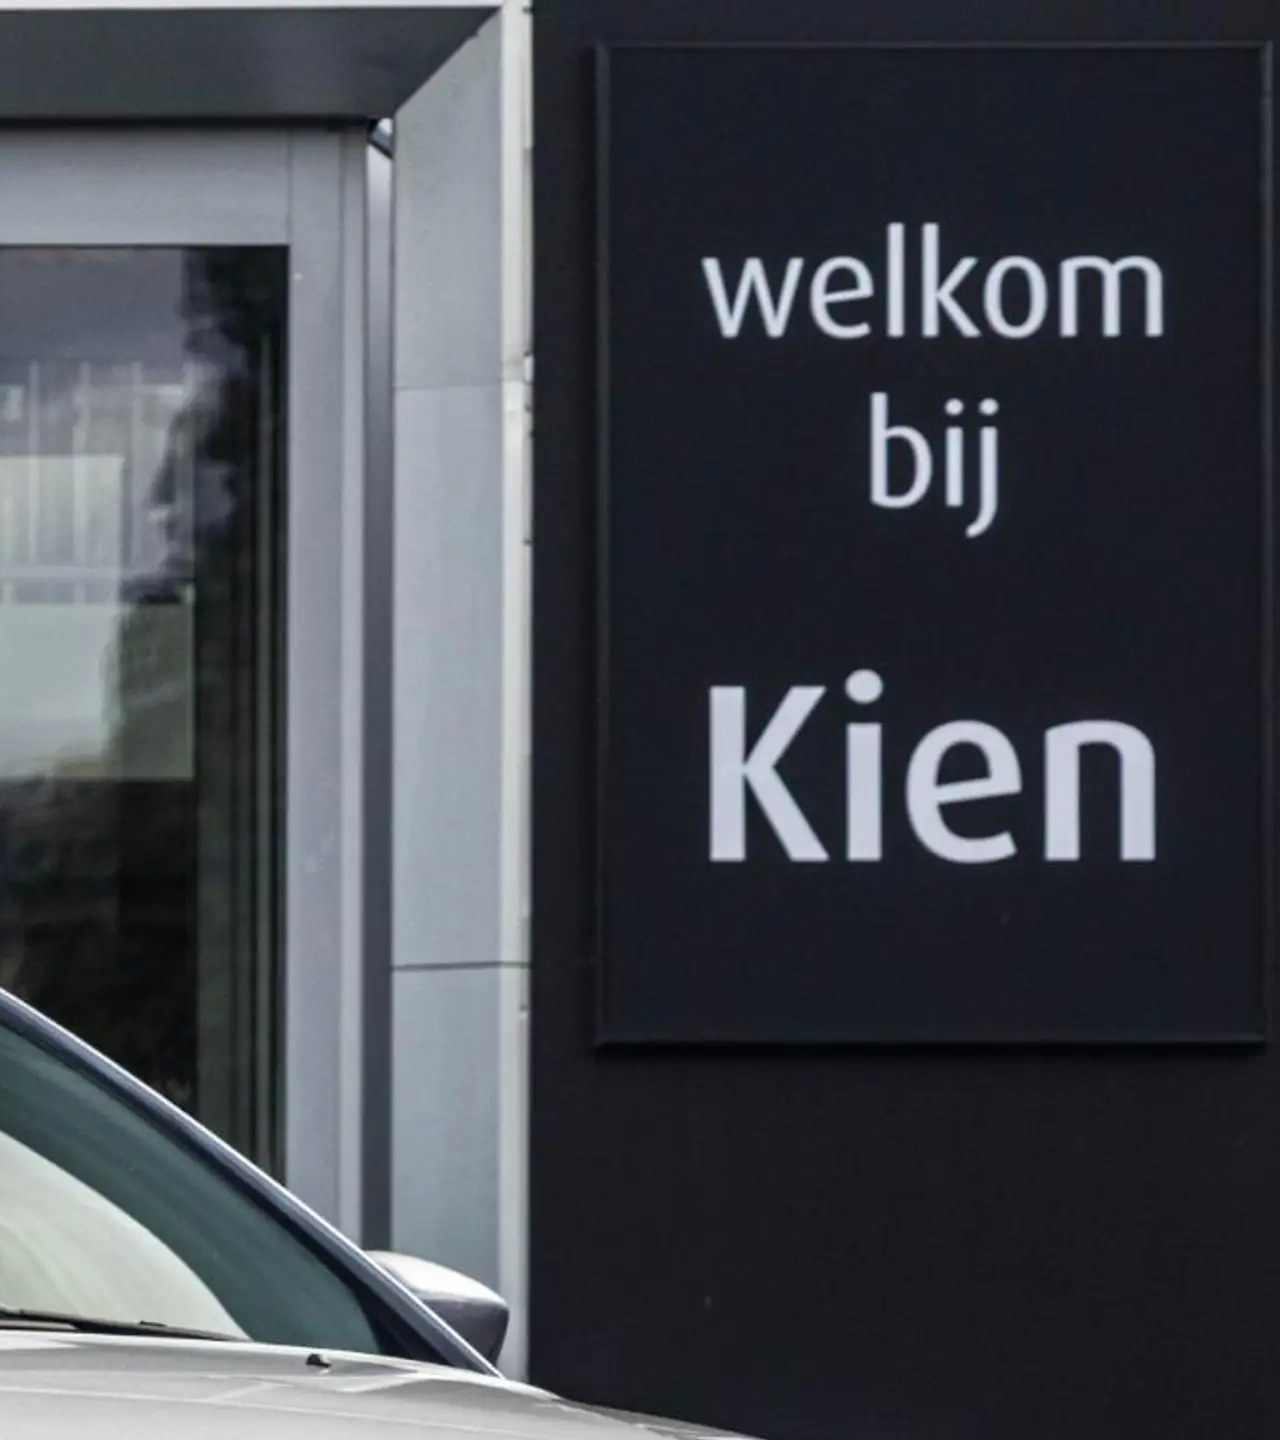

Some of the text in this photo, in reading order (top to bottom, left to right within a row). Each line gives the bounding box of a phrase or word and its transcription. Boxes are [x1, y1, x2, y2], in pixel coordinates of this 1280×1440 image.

[702, 222, 1163, 338] welkom
[870, 391, 999, 537] bij
[710, 668, 1156, 864] Kien
